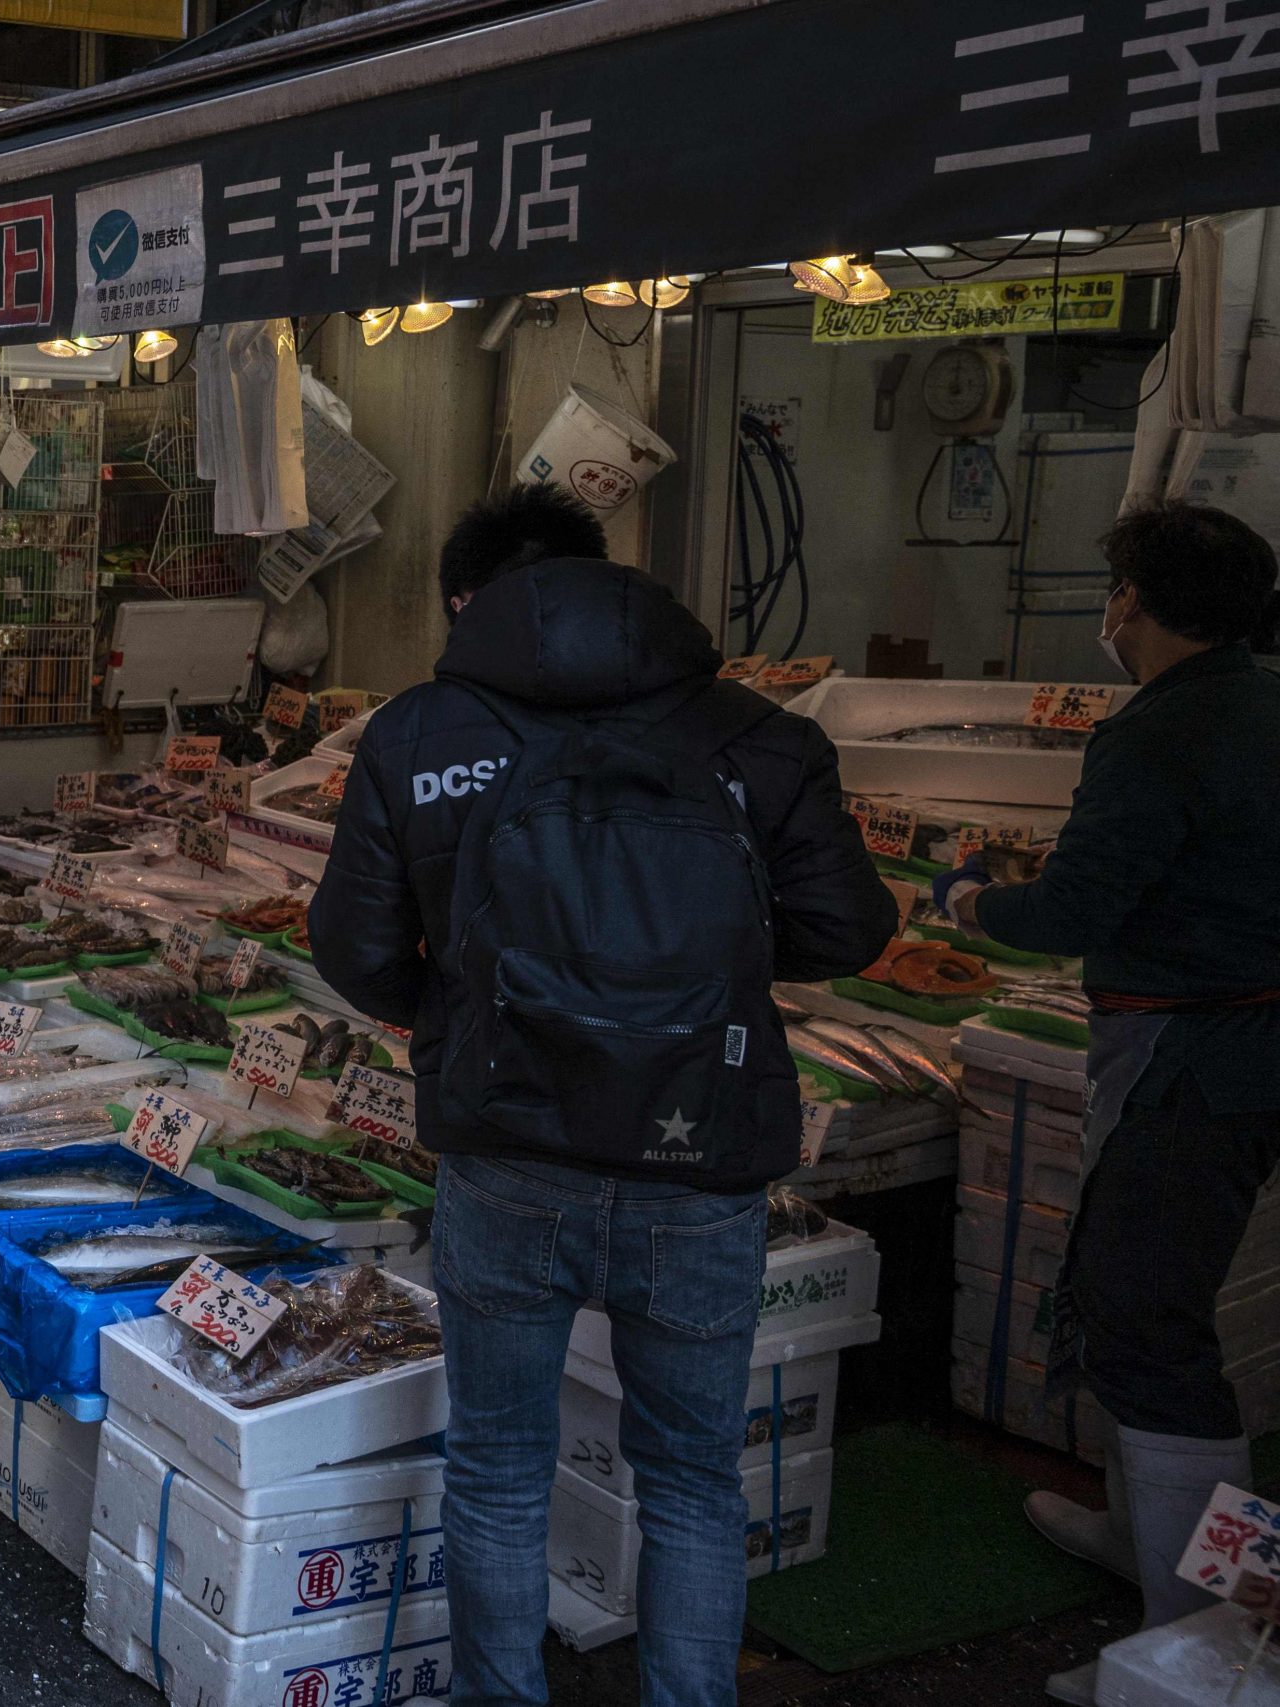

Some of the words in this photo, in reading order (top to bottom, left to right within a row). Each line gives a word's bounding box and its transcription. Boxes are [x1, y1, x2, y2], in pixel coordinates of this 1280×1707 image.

[219, 110, 592, 275] 三幸商店
[142, 225, 190, 251] 微信支付
[96, 276, 186, 304] 購買5,000円以上
[100, 297, 180, 322] 可使用微信支付
